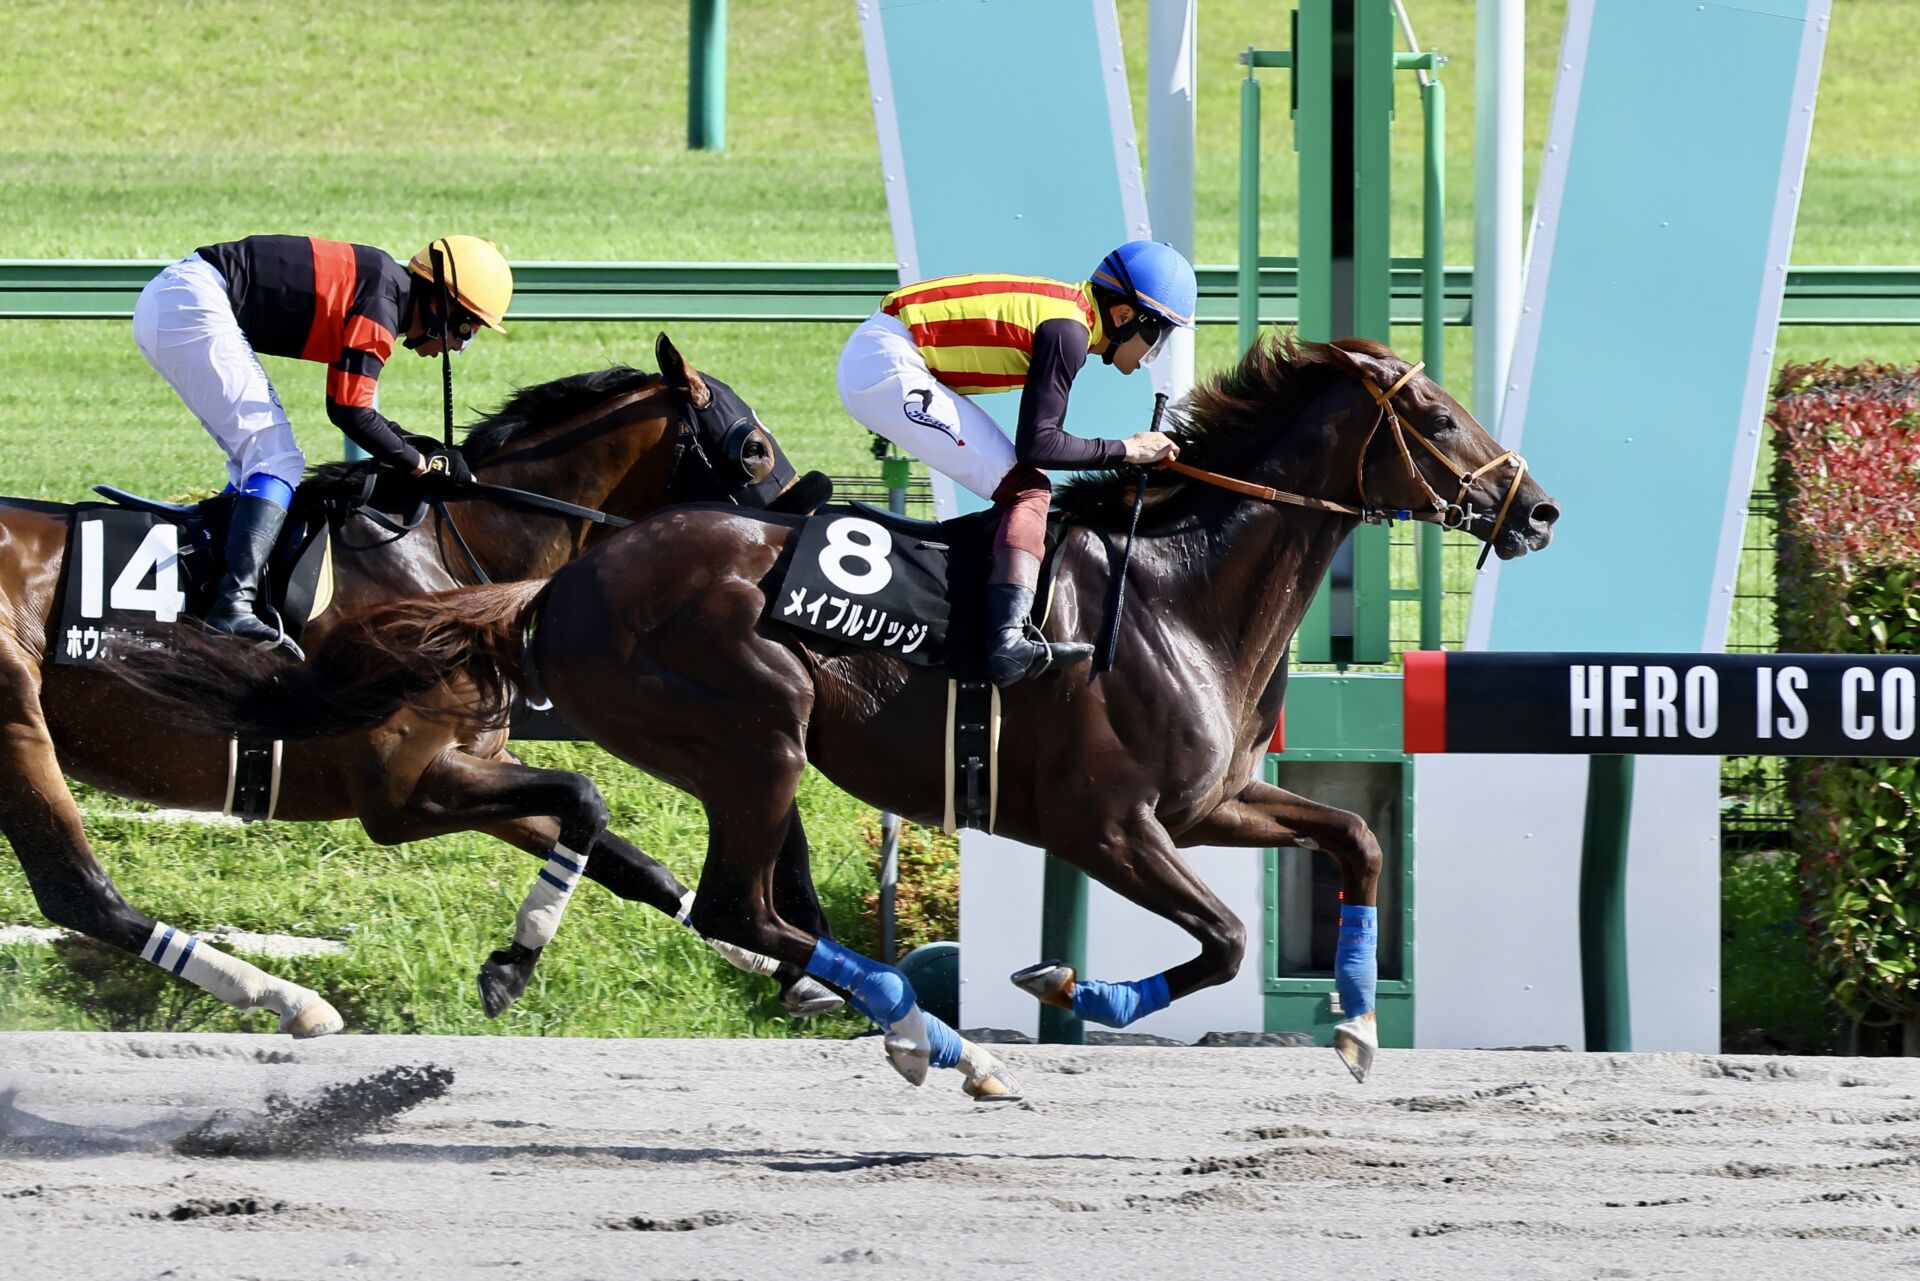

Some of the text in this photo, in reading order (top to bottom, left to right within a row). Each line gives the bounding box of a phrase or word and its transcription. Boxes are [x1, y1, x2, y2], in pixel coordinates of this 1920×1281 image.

[80, 519, 186, 623] 14
[818, 516, 893, 596] 8
[784, 587, 928, 654] メイプルリッジ
[1570, 664, 1916, 741] HERO IS CO
